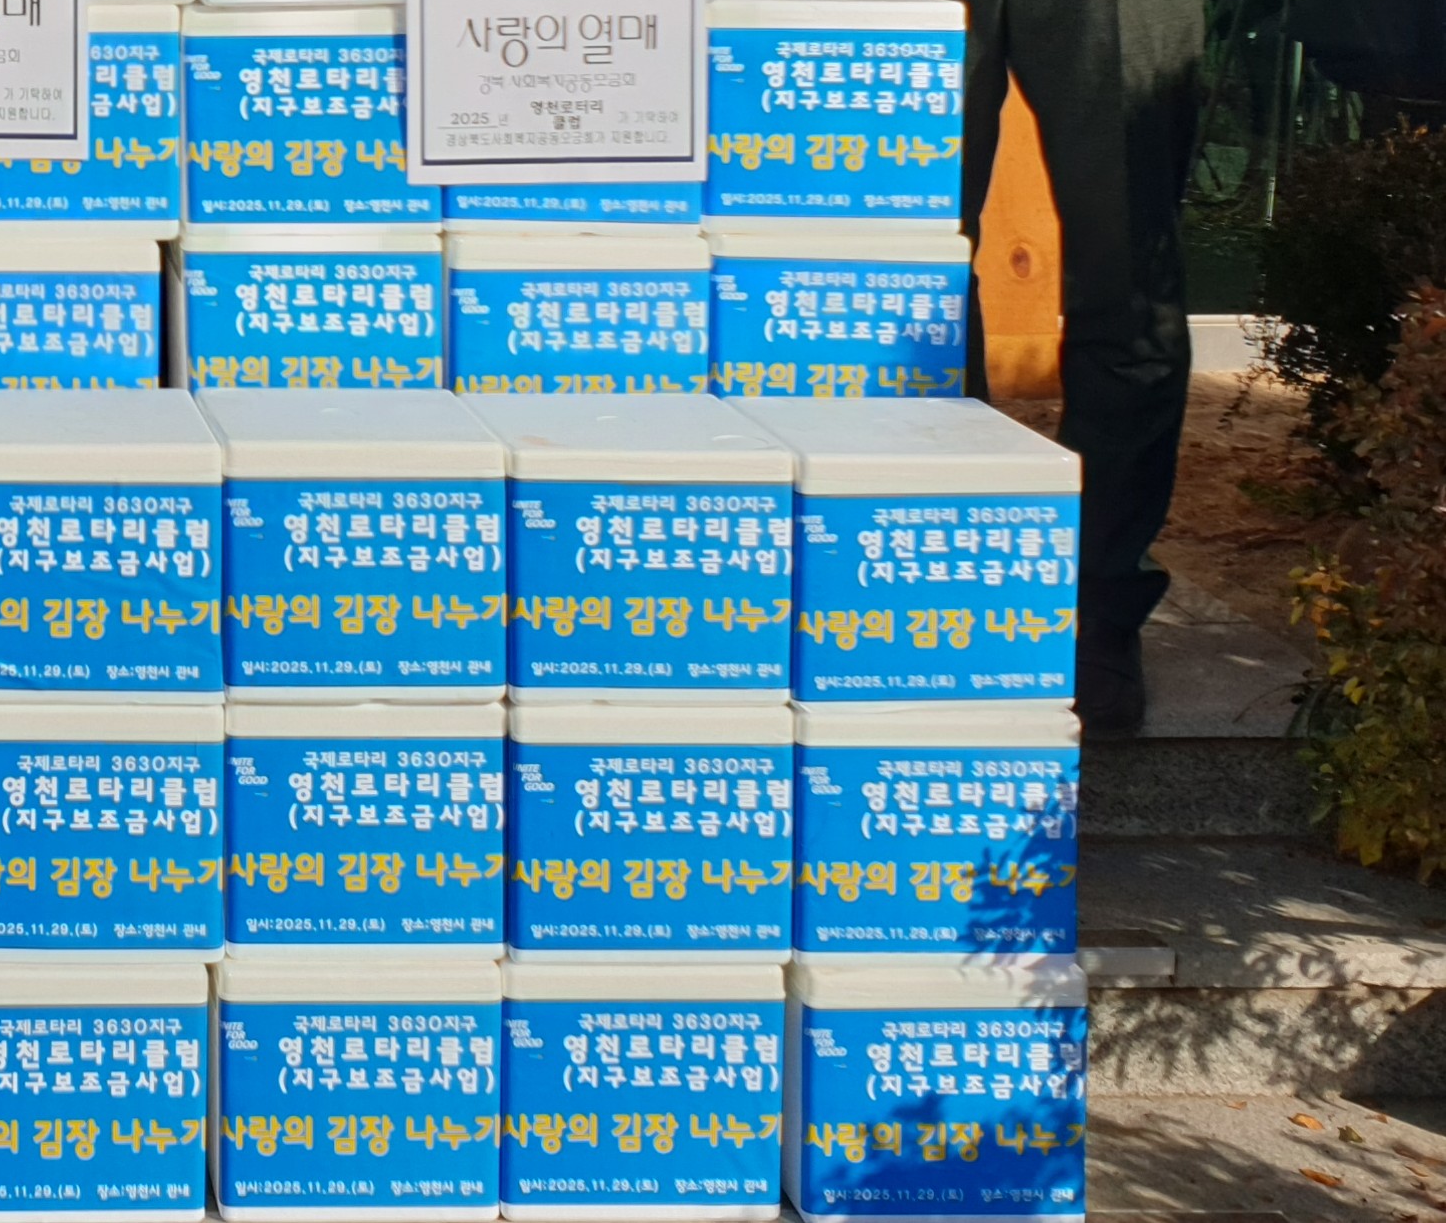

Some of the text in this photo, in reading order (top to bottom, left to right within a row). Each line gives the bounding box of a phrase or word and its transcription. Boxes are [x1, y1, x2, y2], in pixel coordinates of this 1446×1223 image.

[456, 13, 658, 68] 사랑의 열매
[776, 41, 946, 59] 국제로타리 3630지구
[762, 59, 960, 91] 영천로타리클럽
[450, 113, 489, 125] 2025
[530, 99, 604, 115] 영천로터리
[707, 131, 794, 170] 사랑의
[806, 133, 868, 171] 김장
[298, 492, 483, 512] 국제로타리 3630지구
[284, 512, 499, 544] 영천로타리클럽
[284, 545, 500, 572] (지구보조금사업)
[225, 593, 509, 635] 사랑의 김장 나누기
[578, 1013, 762, 1032] 국제로타리 3630지구
[564, 1033, 778, 1065] 영천로타리클럽
[563, 1065, 778, 1092] (지구보조금사업)
[503, 1113, 598, 1154] 사랑의
[611, 1113, 678, 1153] 김장
